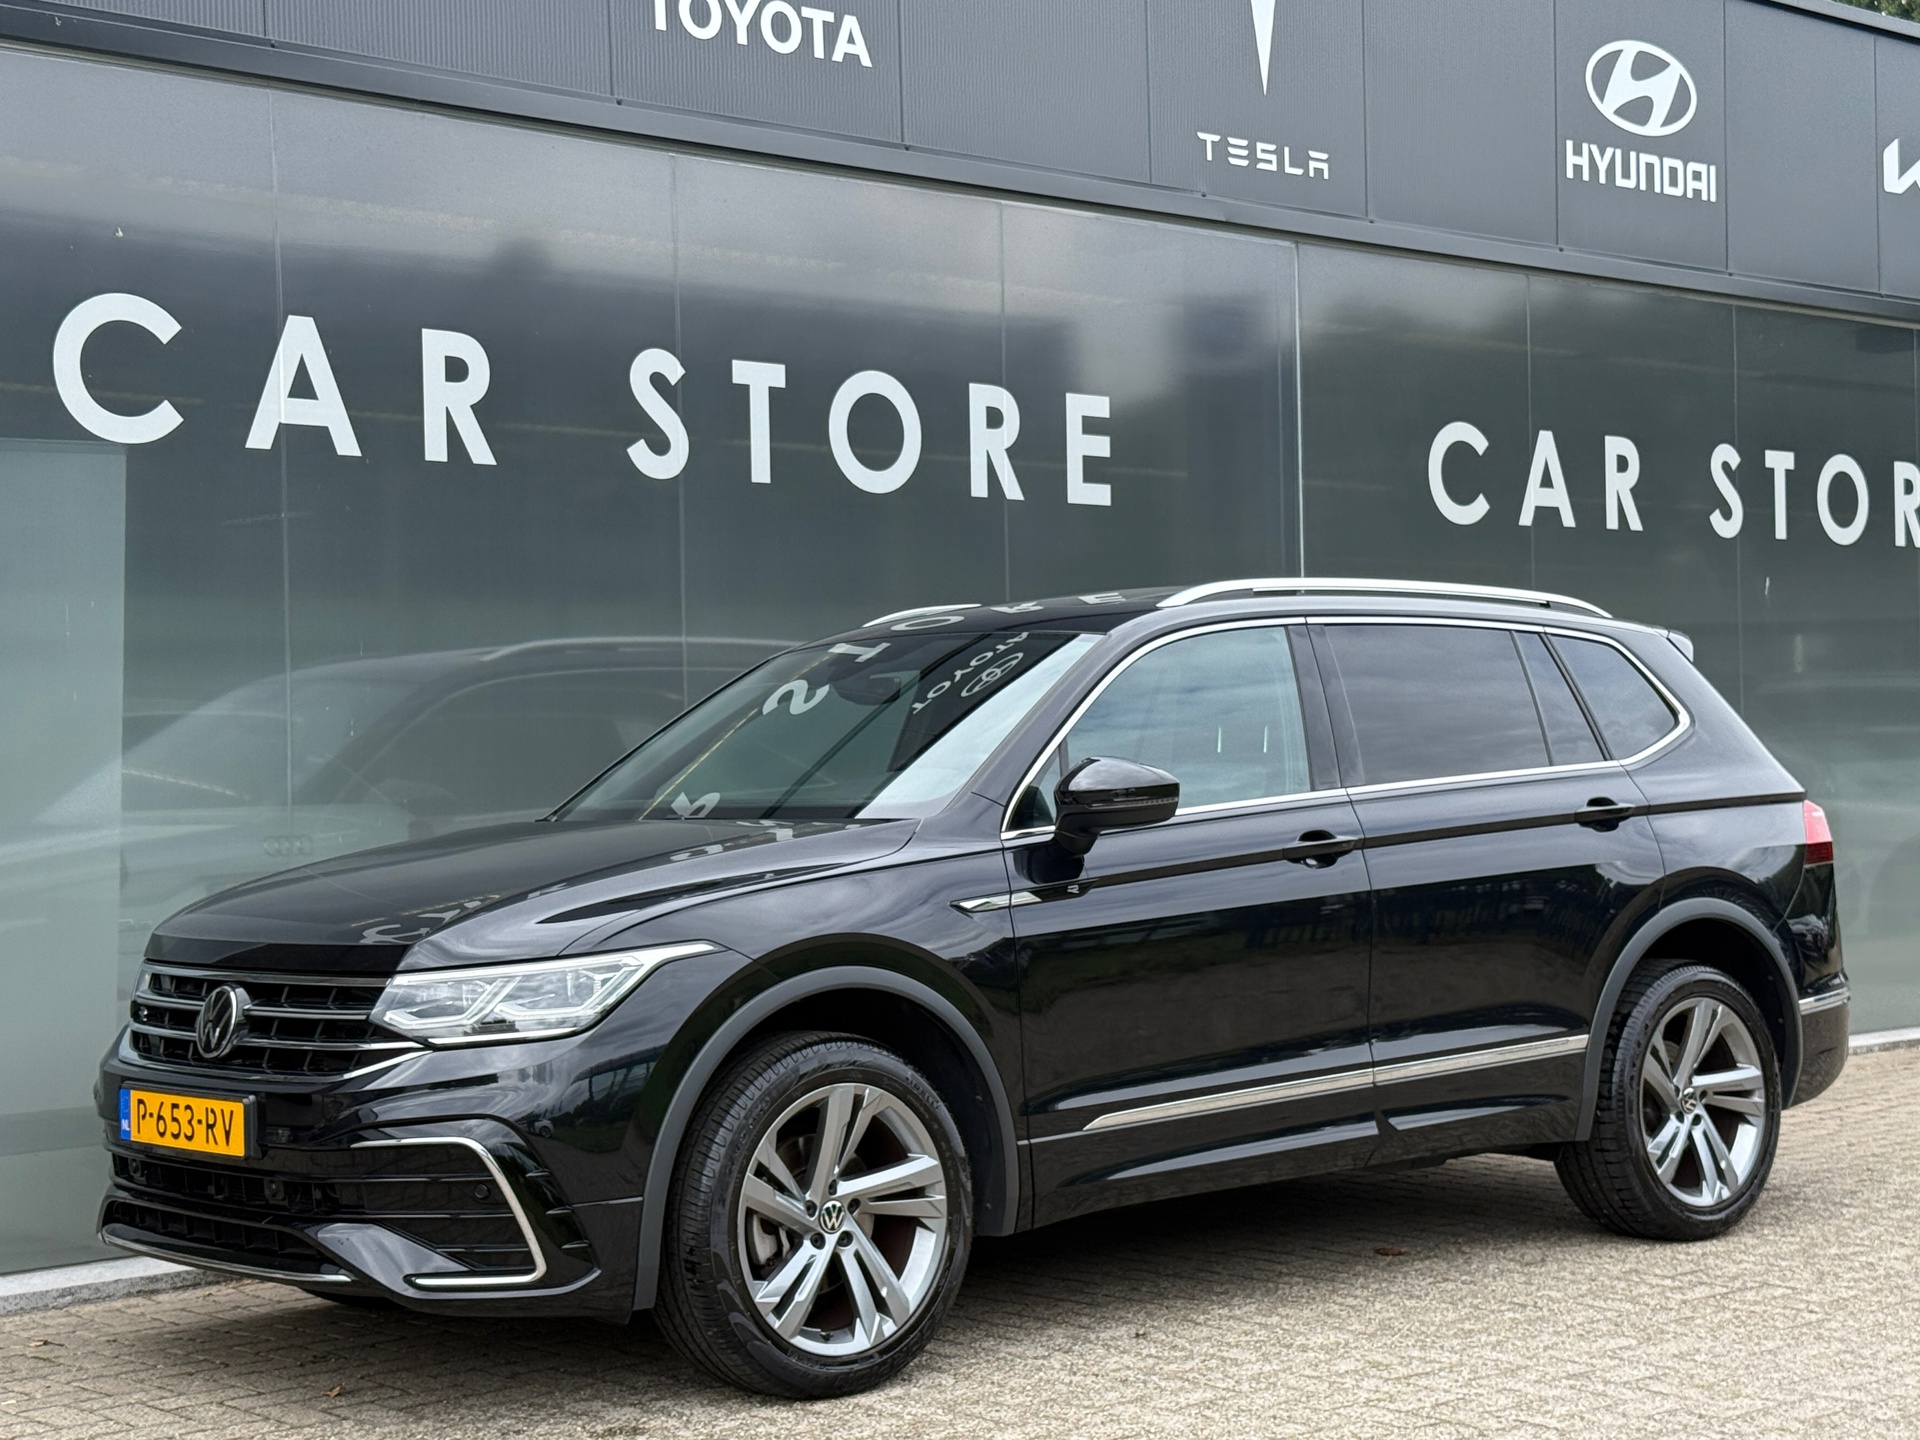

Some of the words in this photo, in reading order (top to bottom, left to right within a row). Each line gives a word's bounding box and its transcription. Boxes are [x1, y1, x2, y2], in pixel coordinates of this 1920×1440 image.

[1196, 131, 1329, 180] TESLA
[1565, 139, 1717, 203] HYUNDAI
[53, 292, 497, 466] CAR
[626, 348, 1112, 506] STORE
[1428, 421, 1643, 531] CAR
[1709, 443, 1920, 548] STOR
[121, 1119, 130, 1131] NL
[136, 1097, 234, 1147] P-653-RV
